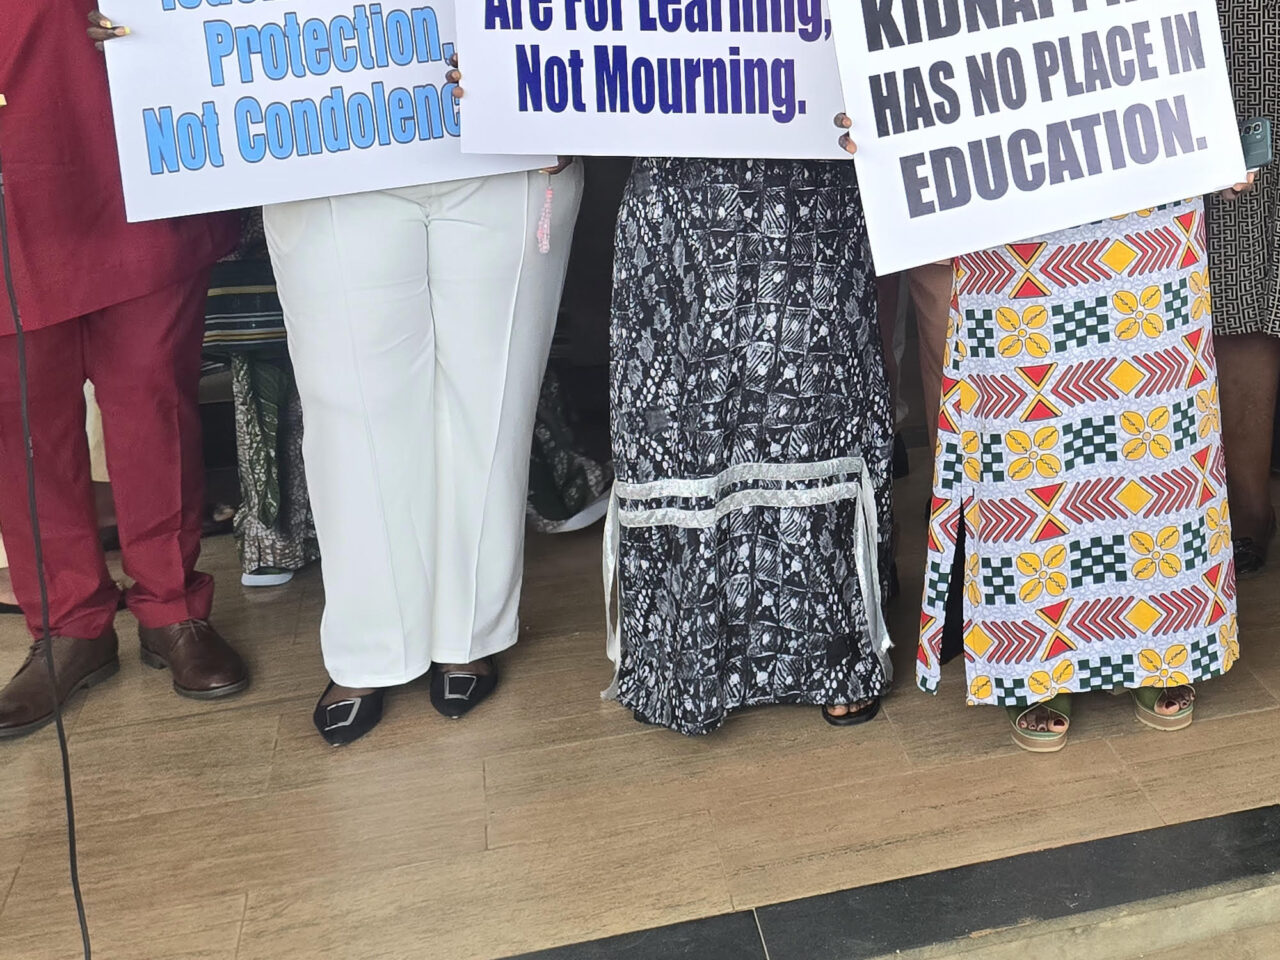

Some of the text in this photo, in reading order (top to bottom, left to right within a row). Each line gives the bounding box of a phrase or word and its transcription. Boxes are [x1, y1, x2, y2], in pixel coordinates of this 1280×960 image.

[204, 3, 455, 86] Protection,
[515, 44, 806, 123] Not Mourning.
[868, 11, 1206, 138] HAS NO PLACE IN
[142, 82, 460, 175] Not Condolenc
[899, 94, 1208, 219] EDUCATION.
